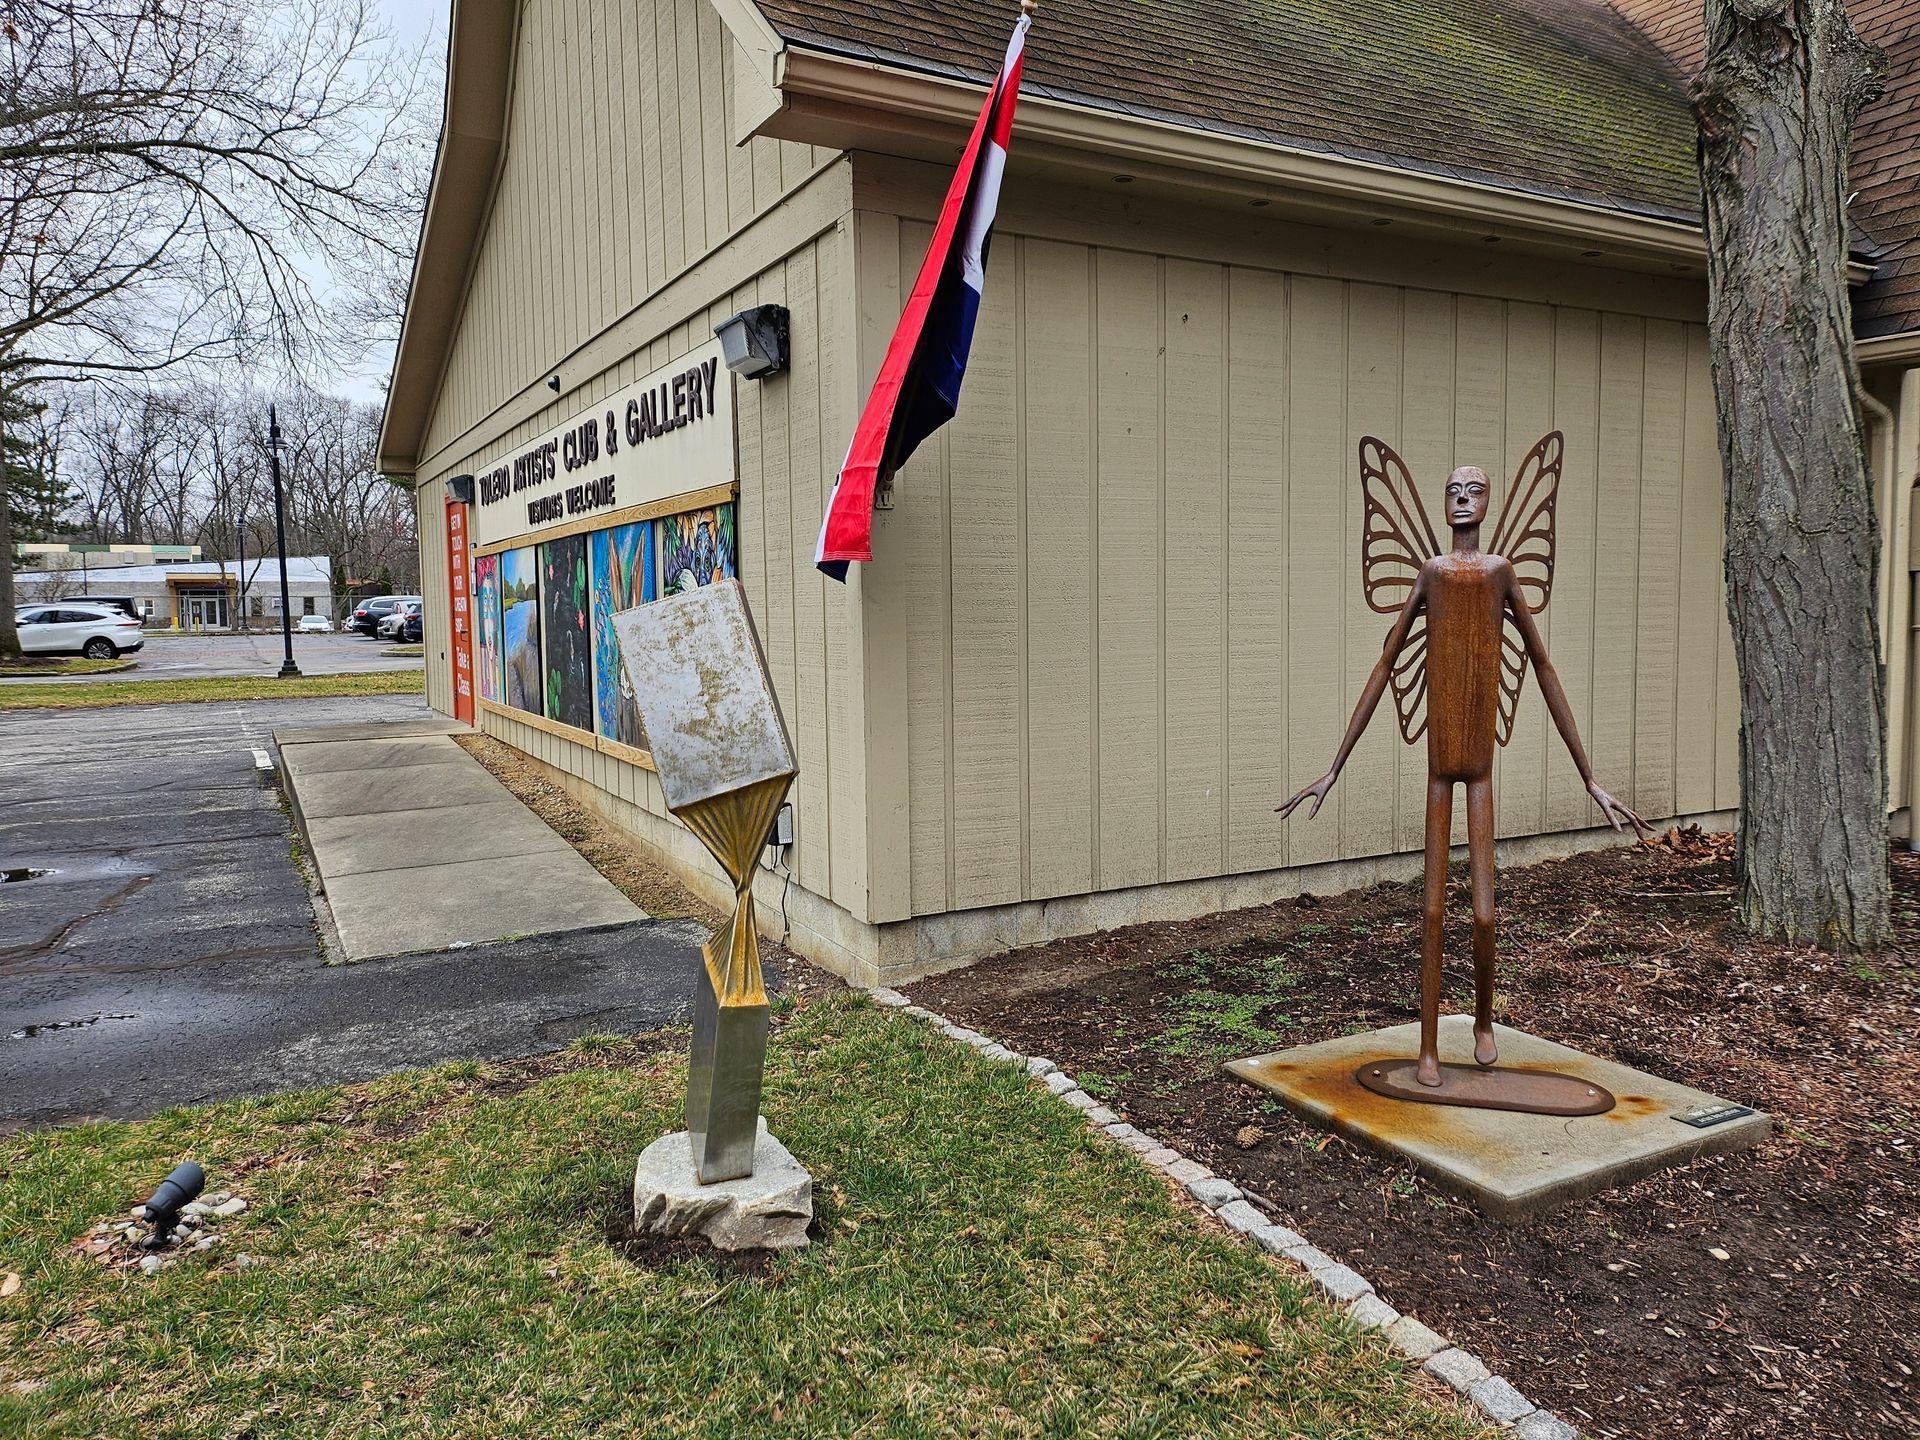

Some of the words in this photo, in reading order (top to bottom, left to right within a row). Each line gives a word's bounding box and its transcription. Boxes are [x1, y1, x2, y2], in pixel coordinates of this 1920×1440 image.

[479, 464, 510, 506] TOLEDO
[513, 437, 558, 492] ARTISTS'
[563, 418, 599, 473] CLUB
[605, 410, 618, 456] &
[625, 356, 718, 447] GALLERY
[527, 492, 563, 525] VISITORS
[565, 474, 616, 514] WELCOME
[452, 535, 462, 551] TOUCH
[456, 646, 467, 669] Take
